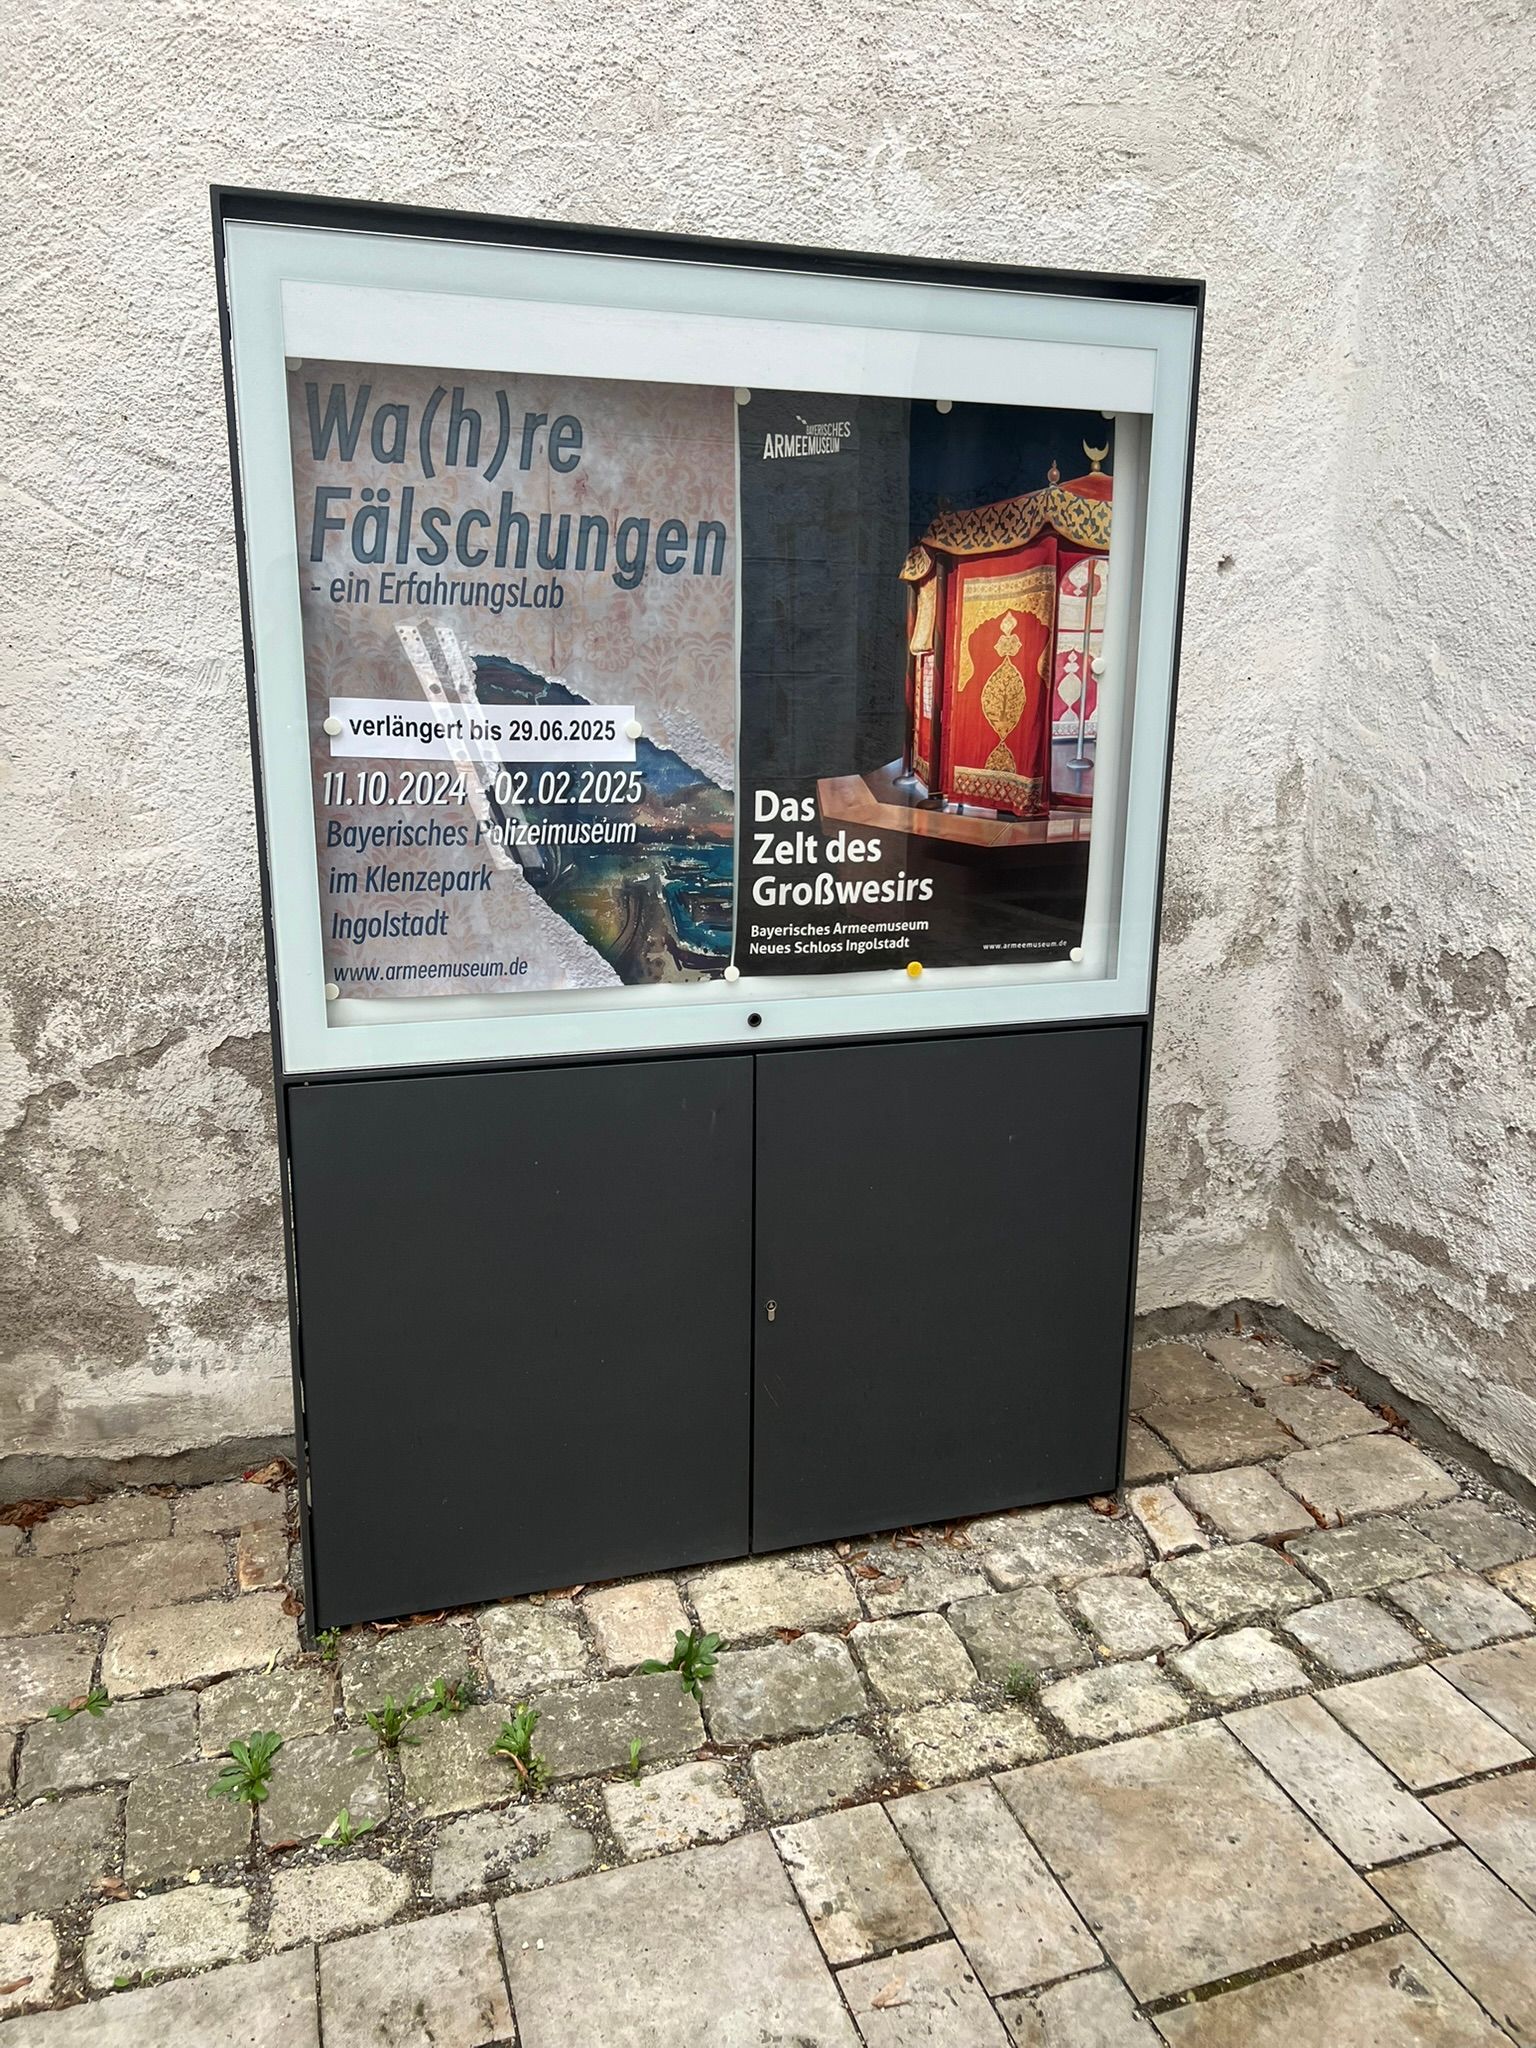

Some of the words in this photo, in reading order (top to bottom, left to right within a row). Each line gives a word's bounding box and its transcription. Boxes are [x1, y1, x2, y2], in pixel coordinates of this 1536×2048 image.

[305, 382, 583, 482] Wa(h)re
[763, 433, 840, 459] ARMEEMUSEUM
[806, 421, 851, 437] BAYERISCHES
[310, 486, 727, 590] Fälschungen
[330, 571, 370, 603] ein
[379, 571, 564, 614] ErfahrungsLab
[349, 715, 464, 745] verlängert
[470, 719, 501, 741] bis
[509, 719, 616, 742] 29.06.2025
[323, 771, 468, 806] 11.10.2024
[495, 770, 644, 805] 02.02.2025
[754, 789, 815, 823] Das
[327, 819, 468, 853] Bayerisches
[475, 818, 637, 847] Polizeimuseum
[752, 831, 818, 865] Zelt
[825, 830, 882, 863] des
[329, 866, 357, 895] im
[365, 864, 492, 897] Klenzepark
[752, 871, 934, 907] Großwesirs
[332, 909, 449, 944] Ingolstadt
[751, 922, 830, 940] Bayerisches
[833, 918, 929, 936] Armeemuseum
[750, 941, 791, 955] Neues
[795, 939, 843, 954] Schloss
[846, 936, 910, 954] Ingolstadt
[983, 939, 1067, 950] www.armeemuseum.de
[334, 956, 528, 982] www.armeemuseum.de
